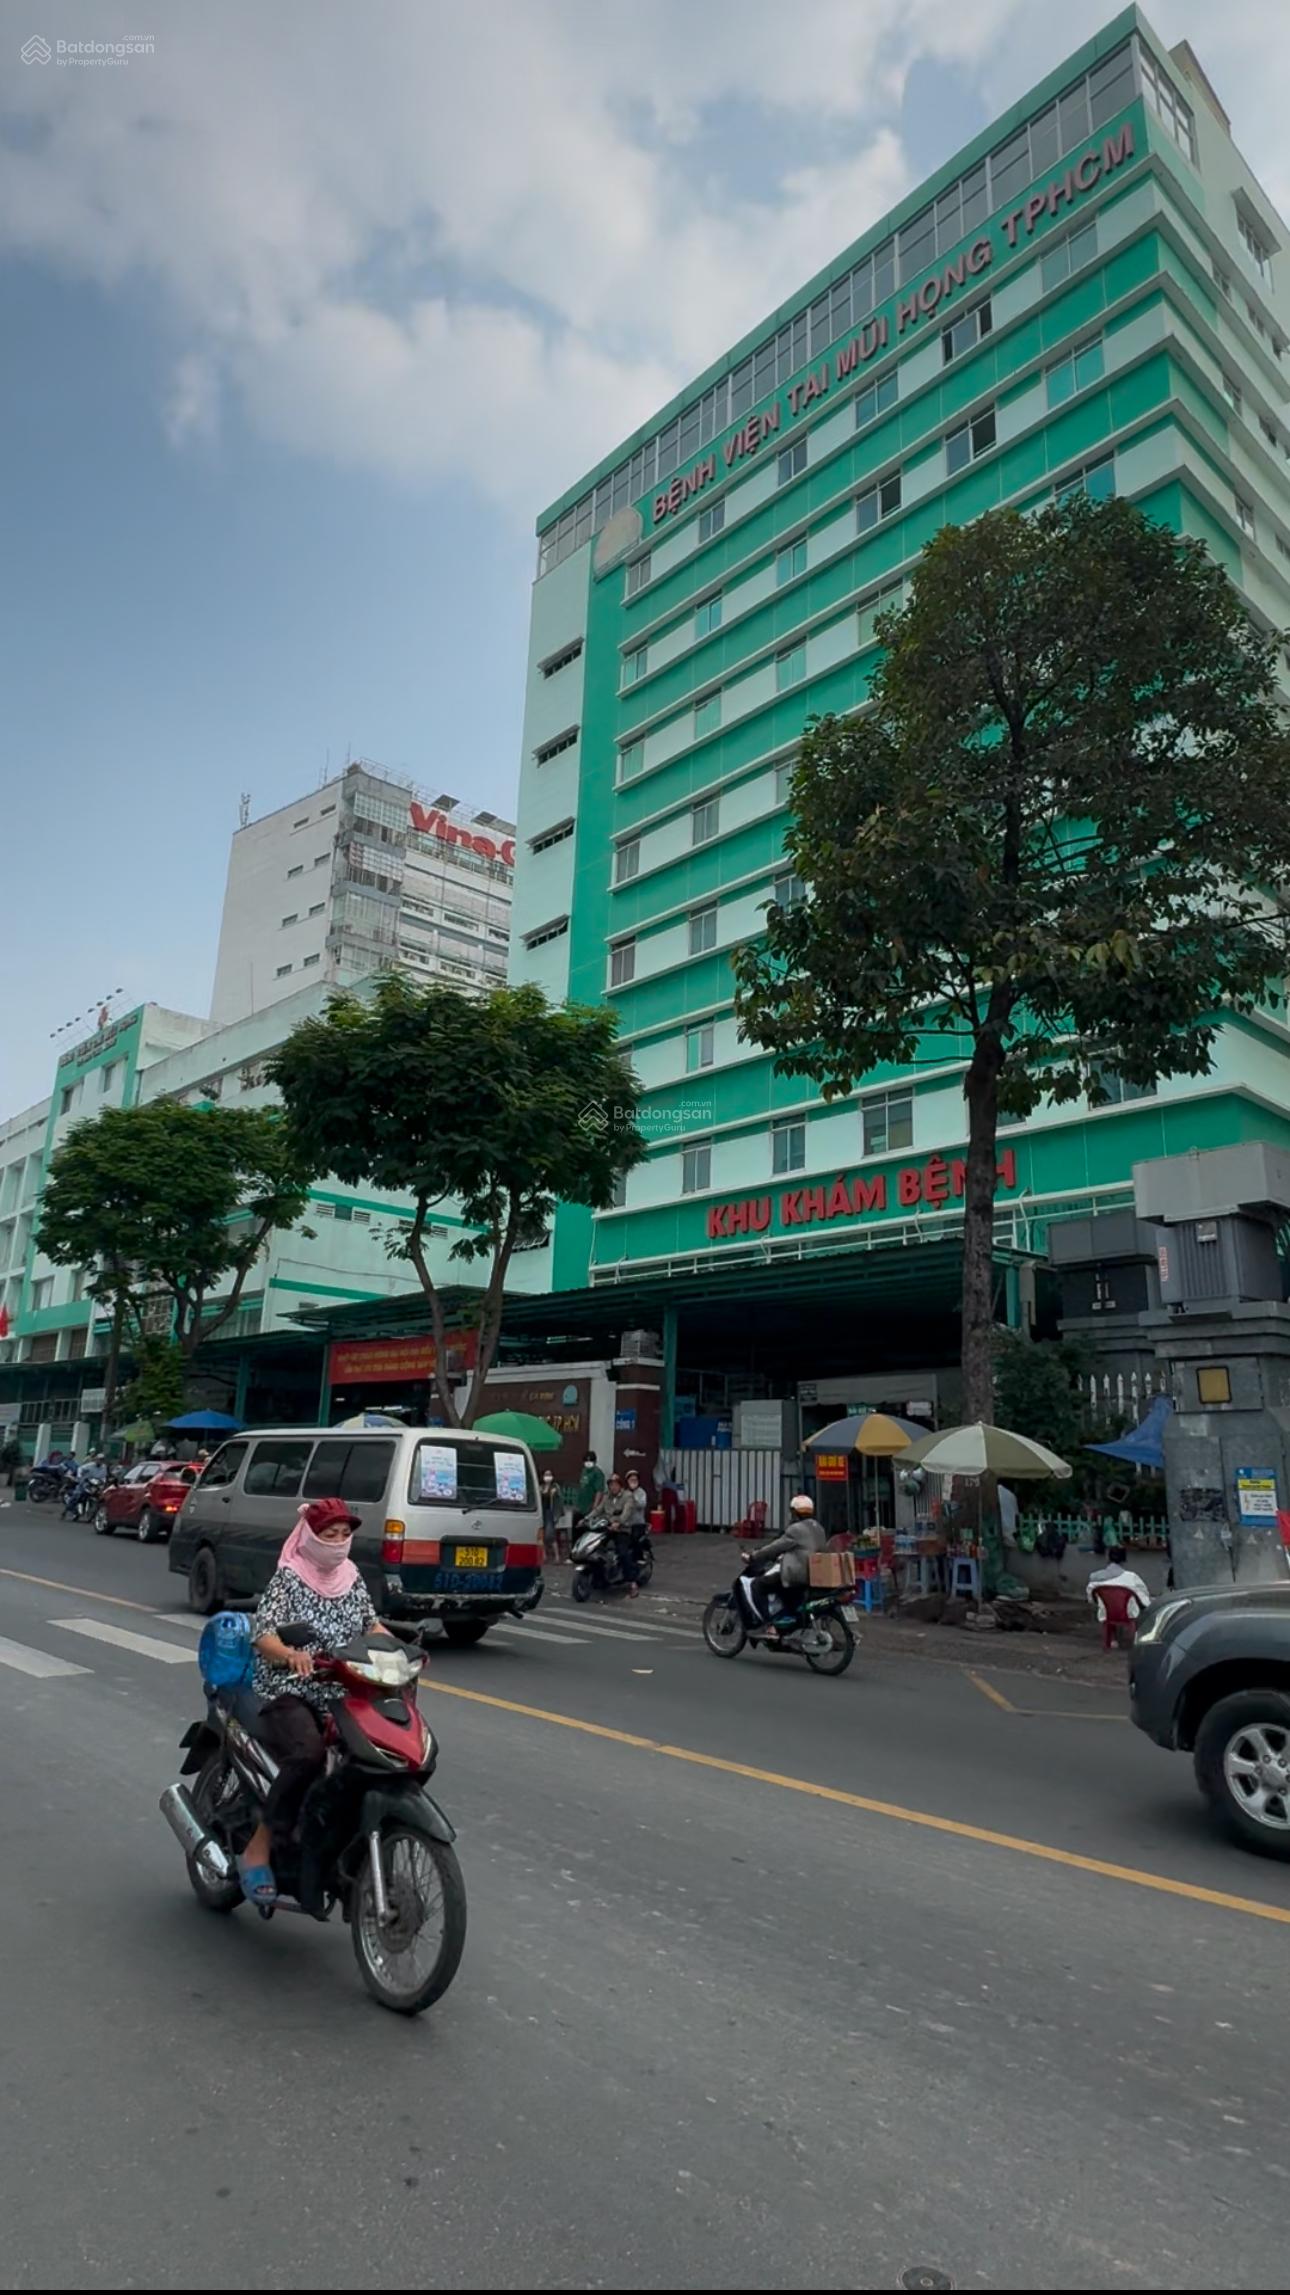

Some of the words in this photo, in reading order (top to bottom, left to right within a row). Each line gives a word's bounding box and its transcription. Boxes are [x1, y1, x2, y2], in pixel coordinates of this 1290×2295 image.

[654, 453, 716, 525] BỆNH
[724, 401, 780, 467] VIỆN
[787, 363, 829, 417] TAI
[836, 315, 889, 382] MŨI
[896, 235, 992, 334] HỌNG
[1001, 122, 1135, 248] TPHCM
[707, 1196, 771, 1239] KHU
[781, 1173, 887, 1226] KHÁM
